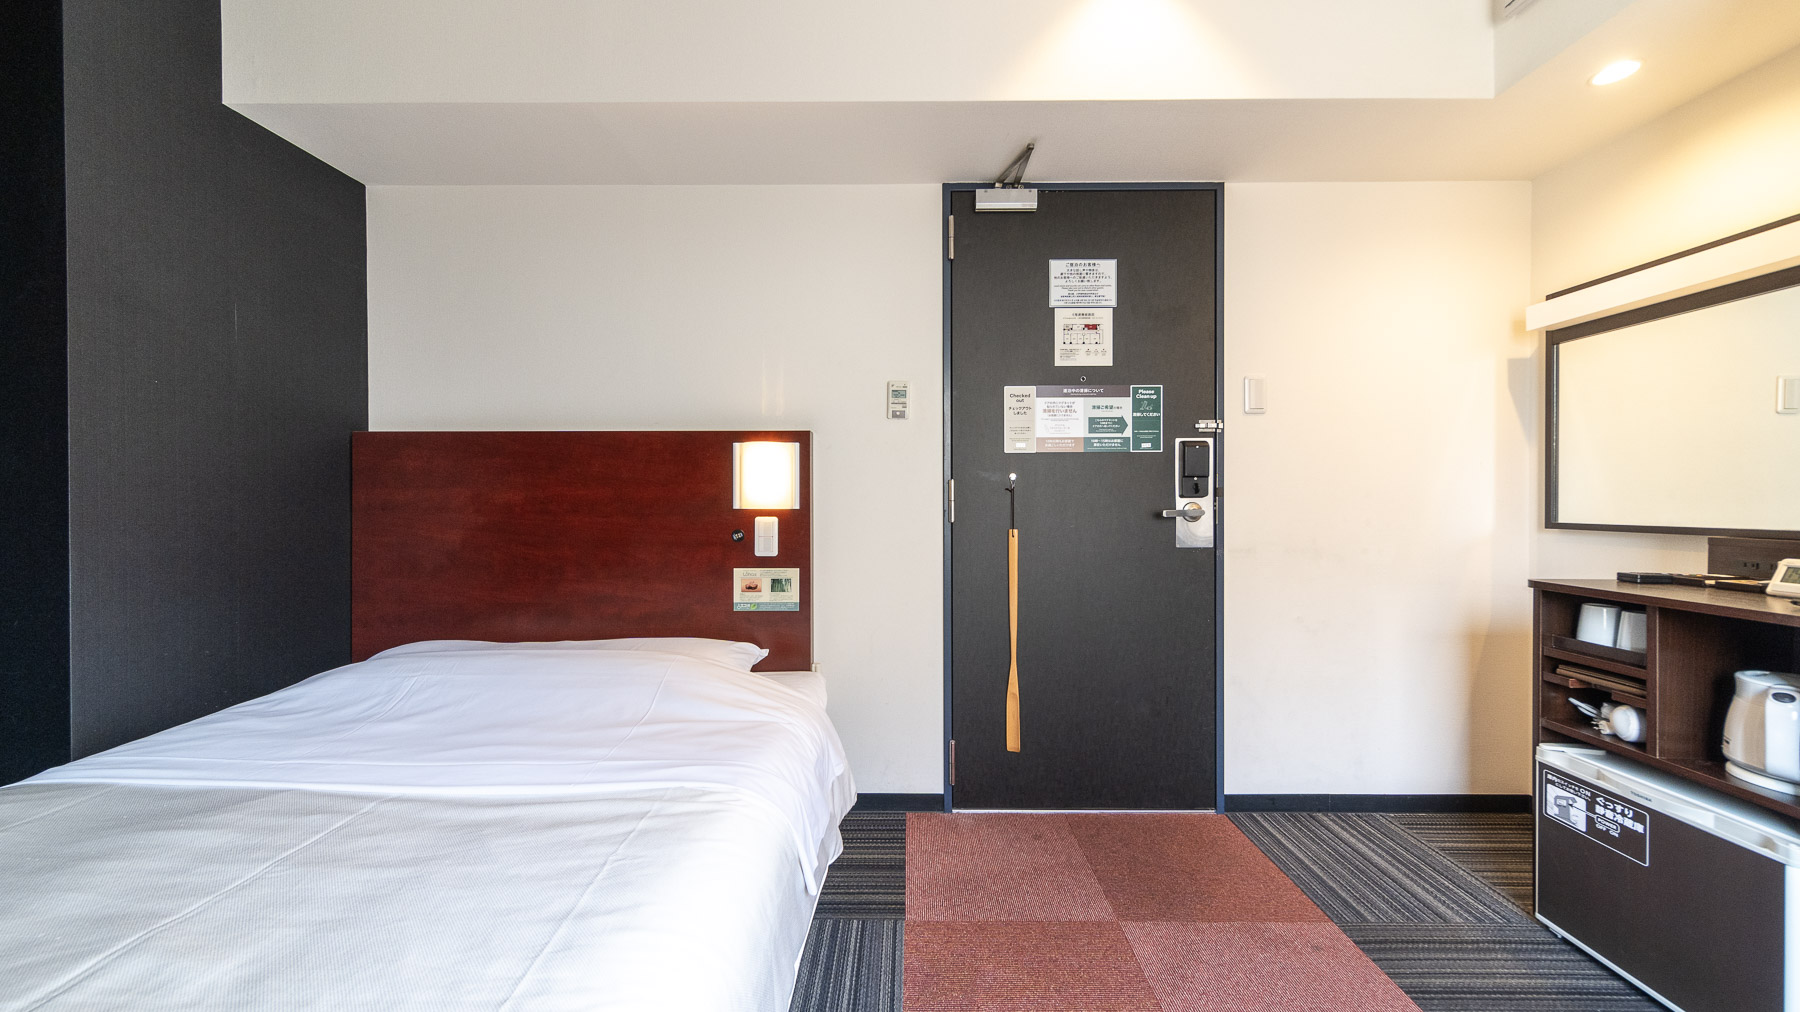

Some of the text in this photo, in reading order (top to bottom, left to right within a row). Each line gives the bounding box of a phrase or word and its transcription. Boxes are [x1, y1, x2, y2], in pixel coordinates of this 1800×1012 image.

[1596, 797, 1633, 818] ぐっすり
[1597, 818, 1617, 830] POWER
